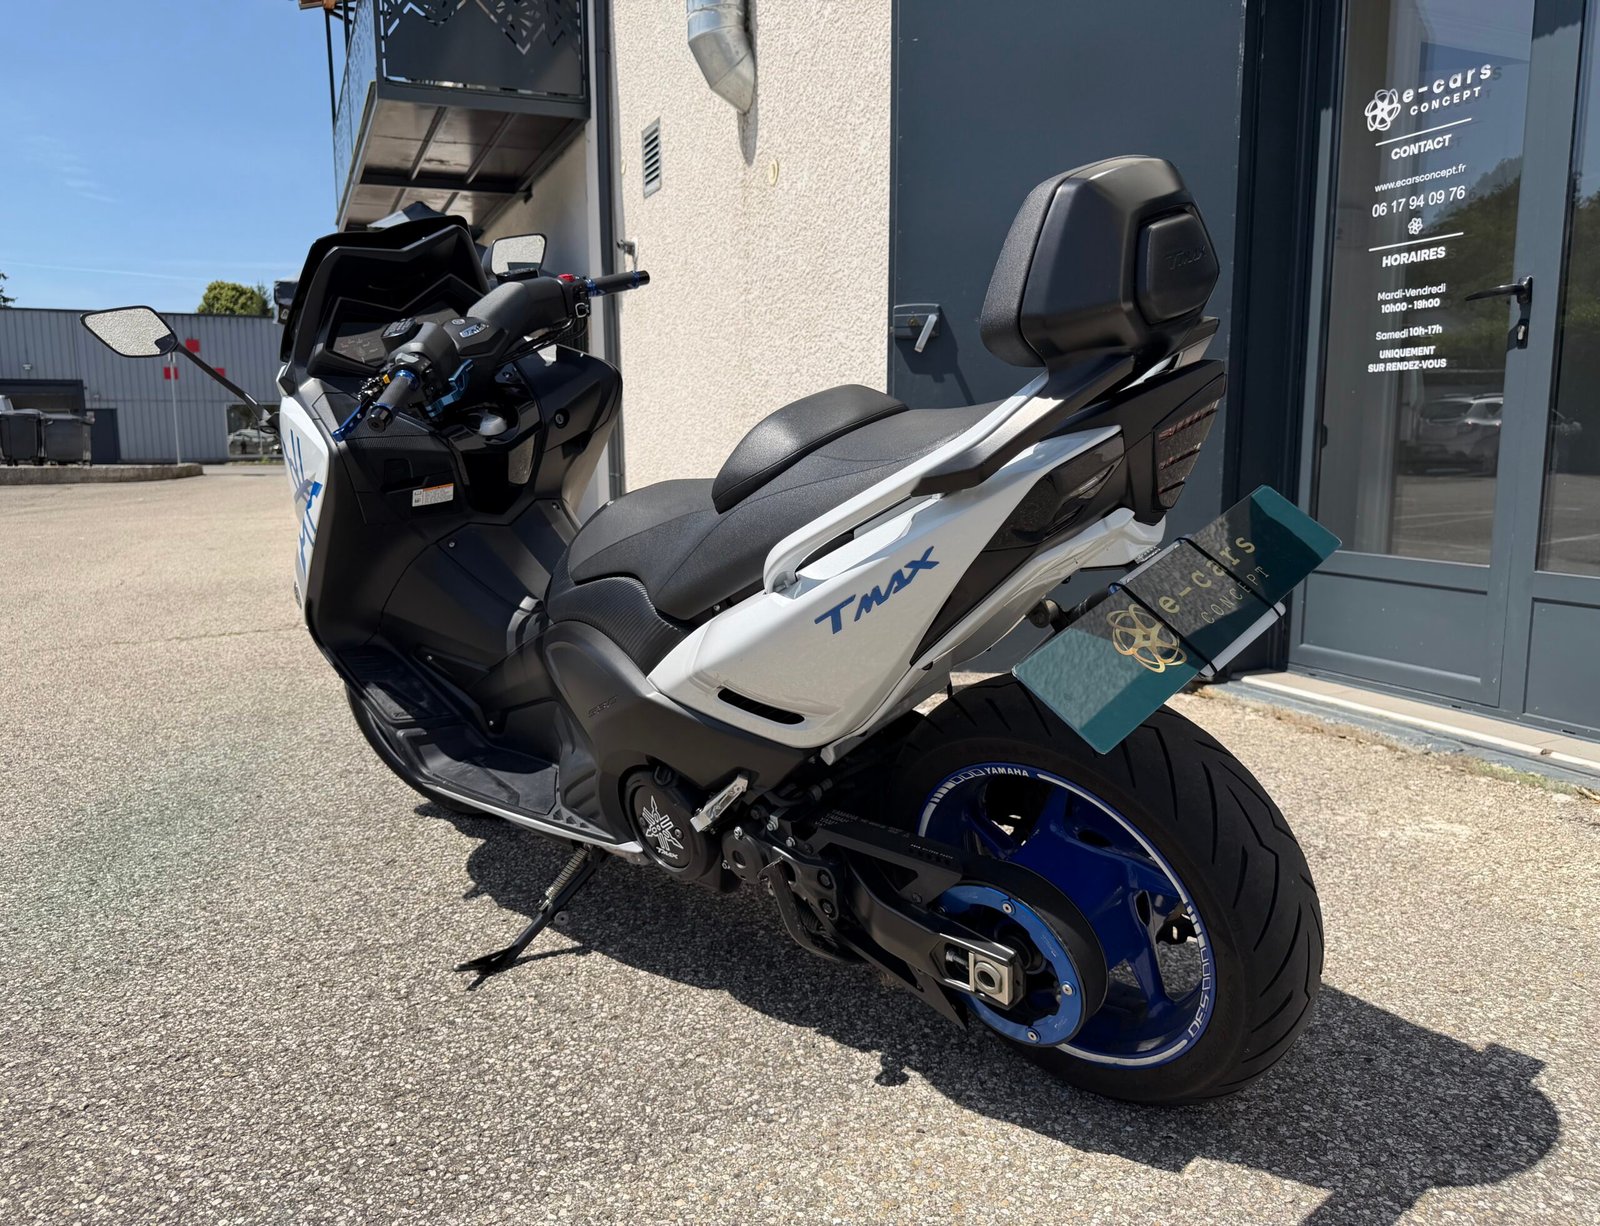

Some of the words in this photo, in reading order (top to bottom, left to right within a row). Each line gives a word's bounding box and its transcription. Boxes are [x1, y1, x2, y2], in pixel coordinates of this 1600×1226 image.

[1402, 64, 1492, 103] e-cars
[1410, 86, 1481, 116] CONCEPT
[1391, 134, 1452, 160] CONTACT
[1374, 163, 1466, 192] www.ecarsconcept.fr
[1372, 202, 1388, 217] 06
[1391, 198, 1406, 213] 17
[1409, 194, 1425, 210] 94
[1428, 190, 1445, 205] 09
[1449, 185, 1466, 201] 76
[1382, 246, 1446, 267] HORAIRES
[1377, 283, 1446, 301] Mardi-Vendredi
[1381, 302, 1407, 314] 10h00
[1375, 328, 1409, 341] Samedi
[1409, 324, 1443, 337] 10h-17h
[1379, 345, 1436, 359] UNIQUEMENT
[1367, 362, 1385, 373] SUR
[1386, 358, 1447, 372] RENDEZ-VOUS
[1158, 536, 1256, 615] e-cars
[814, 545, 940, 635] TMAX
[1201, 565, 1270, 624] CONCEPT
[984, 767, 1030, 778] YAMAHA
